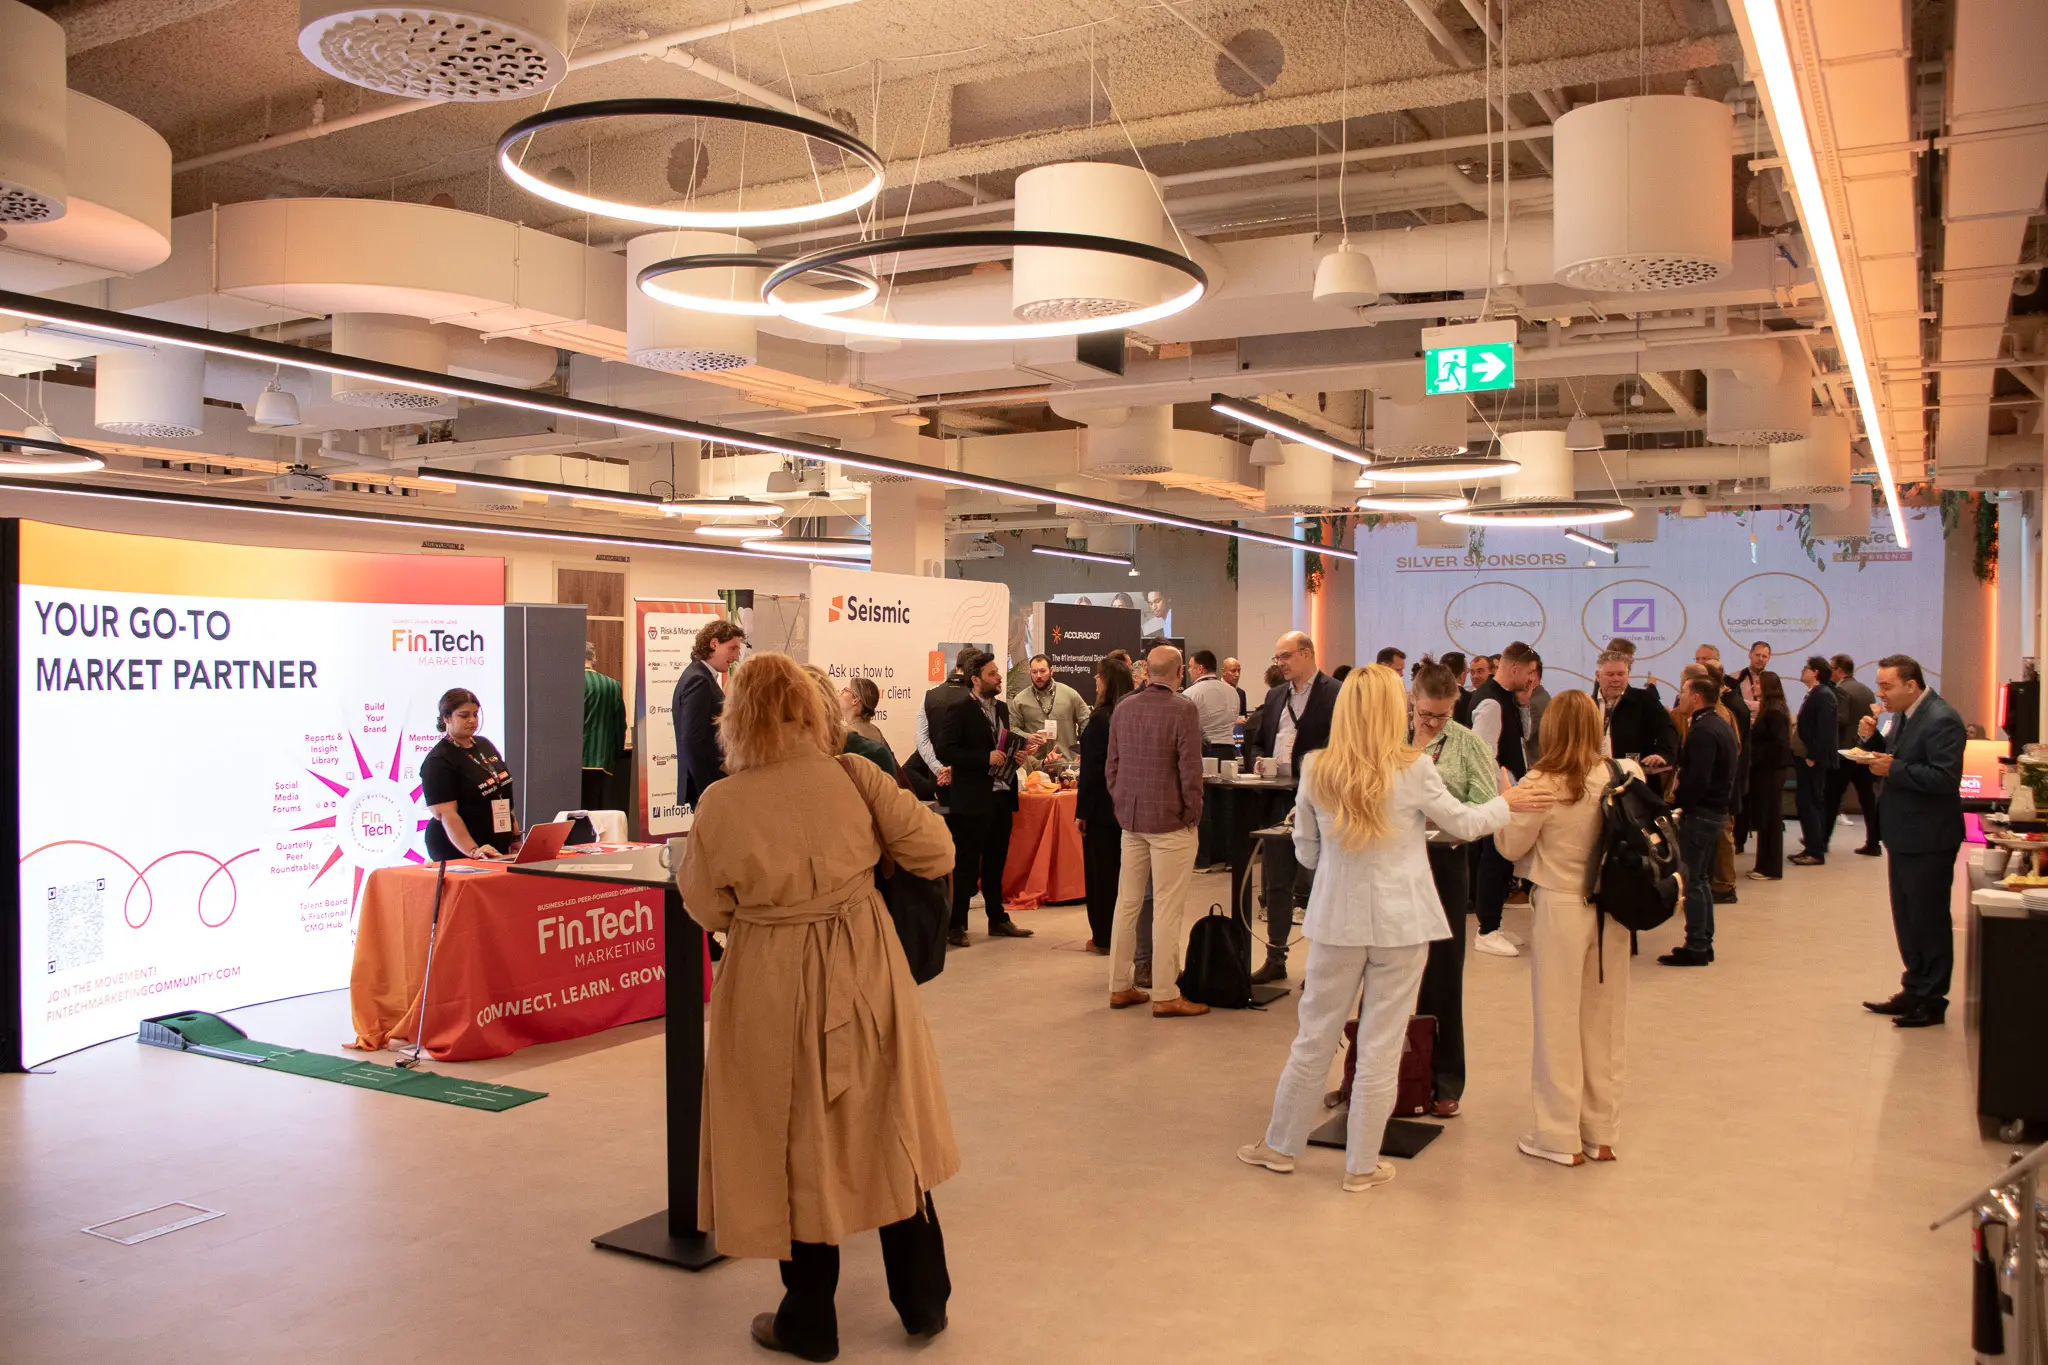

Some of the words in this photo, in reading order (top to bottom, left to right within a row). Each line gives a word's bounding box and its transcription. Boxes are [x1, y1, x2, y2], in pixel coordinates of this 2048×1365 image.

[421, 541, 459, 550] AUDITORIUM
[1396, 555, 1457, 569] SILVER
[1464, 552, 1567, 567] SPONSORS
[847, 596, 910, 624] Seismic
[35, 600, 120, 638] YOUR
[129, 606, 231, 641] GO-TO
[391, 629, 485, 652] Fin.Tech
[1063, 631, 1101, 640] ACCURACAST
[418, 656, 485, 666] MARKETING
[1051, 653, 1061, 662] The
[1061, 654, 1067, 662] #1
[1067, 653, 1093, 662] International
[36, 657, 163, 692] MARKET
[173, 659, 318, 690] PARTNER
[828, 663, 847, 678] Ask
[849, 667, 861, 678] us
[863, 663, 883, 678] how
[885, 665, 894, 678] to
[1052, 664, 1074, 674] Marketing
[1074, 664, 1091, 674] Agency
[887, 685, 911, 699] client
[364, 703, 385, 711] Build
[366, 714, 384, 722] Your
[363, 725, 387, 733] Brand
[305, 734, 335, 743] Reports
[336, 733, 343, 741] &
[310, 744, 338, 754] Insight
[311, 756, 339, 765] Library
[275, 781, 298, 790] Social
[275, 793, 299, 801] Media
[272, 805, 301, 813] Forums
[361, 823, 393, 837] Tech
[276, 840, 313, 851] Quarterly
[286, 852, 303, 860] Peer
[270, 862, 319, 874] Roundtables
[300, 900, 323, 910] Talent
[325, 898, 348, 907] Board
[537, 900, 578, 911] BUSINESS-LED.
[577, 890, 619, 904] PEER-POWERED
[301, 913, 306, 921] &
[308, 909, 347, 920] Fractional
[304, 924, 325, 933] CMO
[326, 921, 343, 930] Hub
[538, 900, 654, 954] Fin.Tech
[575, 937, 656, 968] MARKETING
[48, 988, 71, 1004] JOIN
[74, 981, 92, 996] THE
[94, 966, 158, 990] MOVEMENT!
[46, 966, 241, 1023] FINTECHMARKETINGCOMMUNITY.COM
[476, 992, 557, 1028] CONNECT.
[561, 977, 615, 1005] LEARN.
